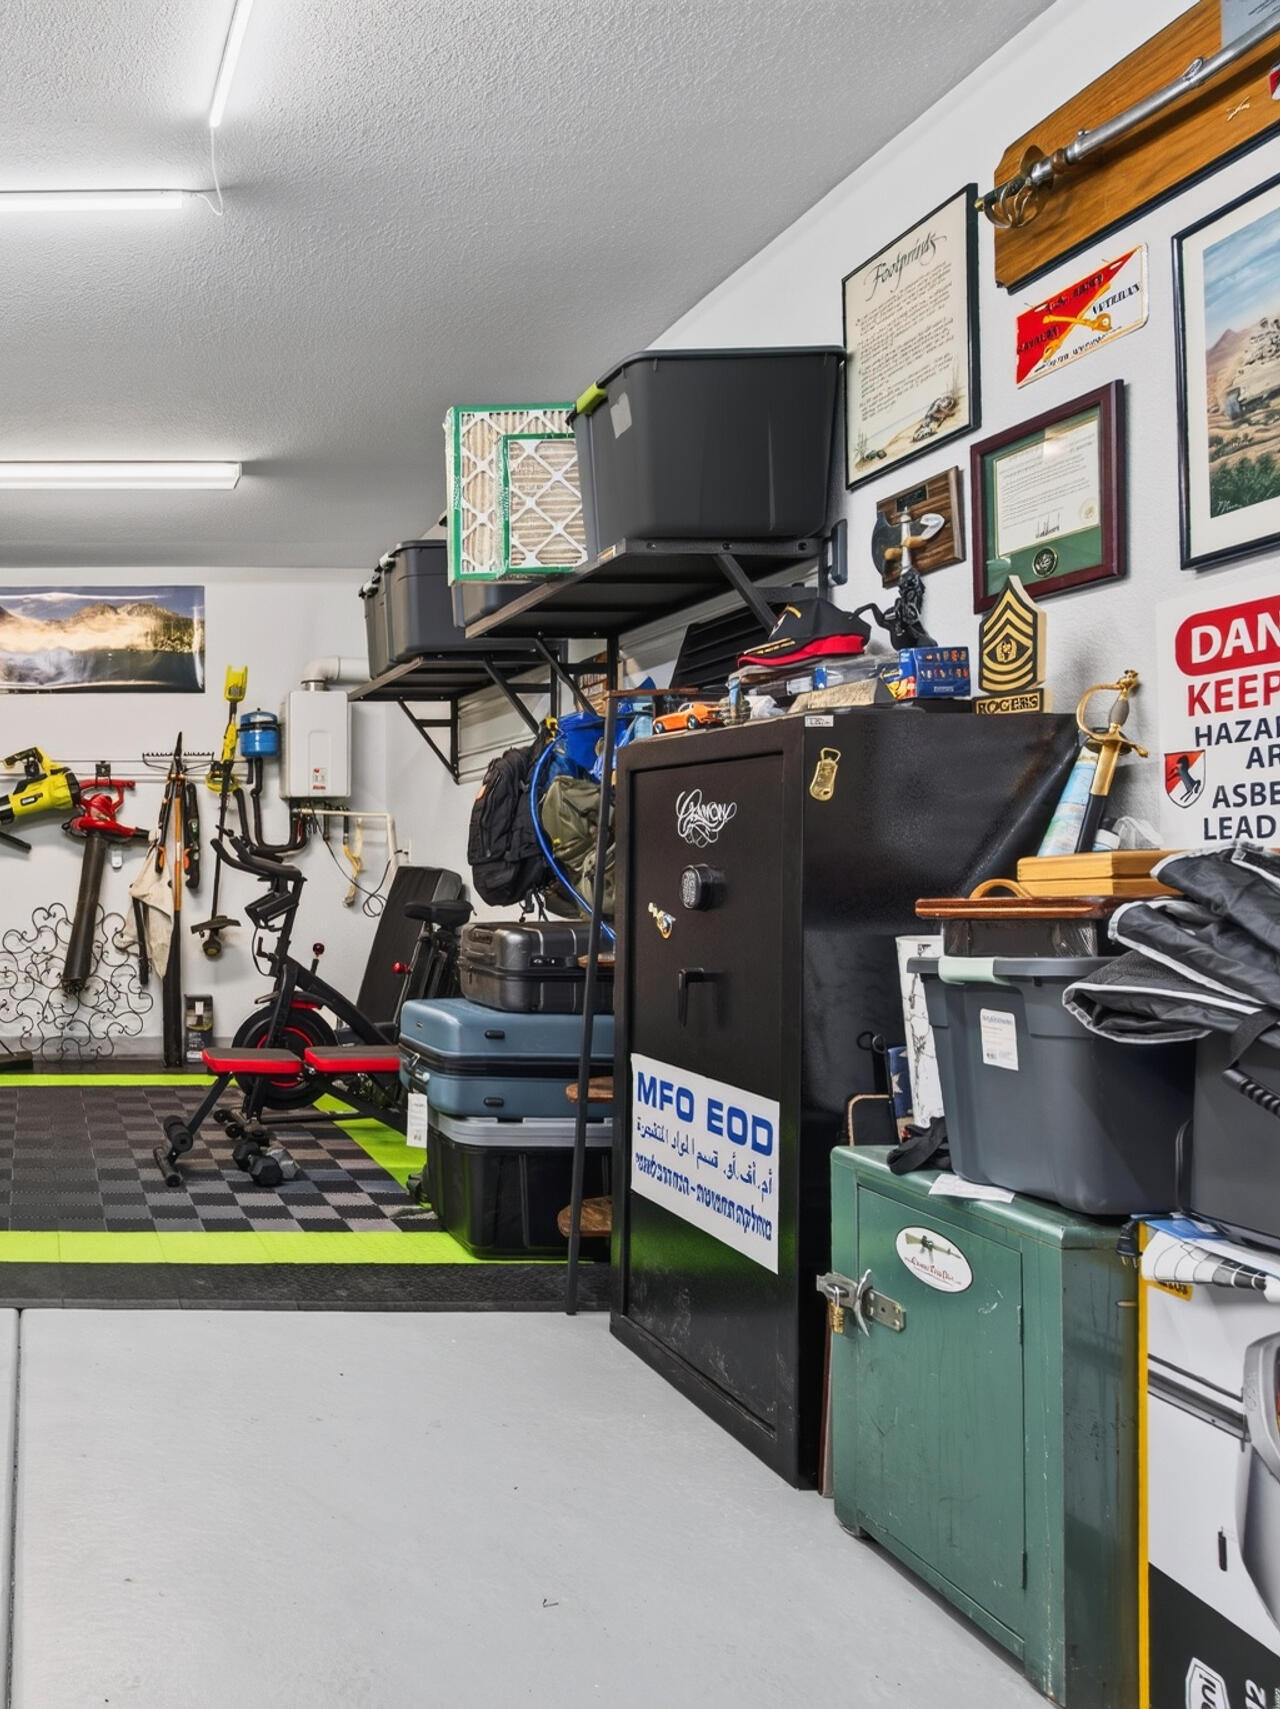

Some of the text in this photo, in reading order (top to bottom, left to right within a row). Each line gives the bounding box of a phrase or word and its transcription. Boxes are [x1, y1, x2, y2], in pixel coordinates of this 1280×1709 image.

[864, 232, 948, 302] Footprints
[977, 695, 1039, 716] ROGERS
[1188, 670, 1280, 717] KEEP
[1195, 715, 1280, 748] HAZA
[1212, 781, 1280, 808] ASBE
[1203, 815, 1276, 841] LEAD
[637, 1071, 774, 1157] MFO EOD
